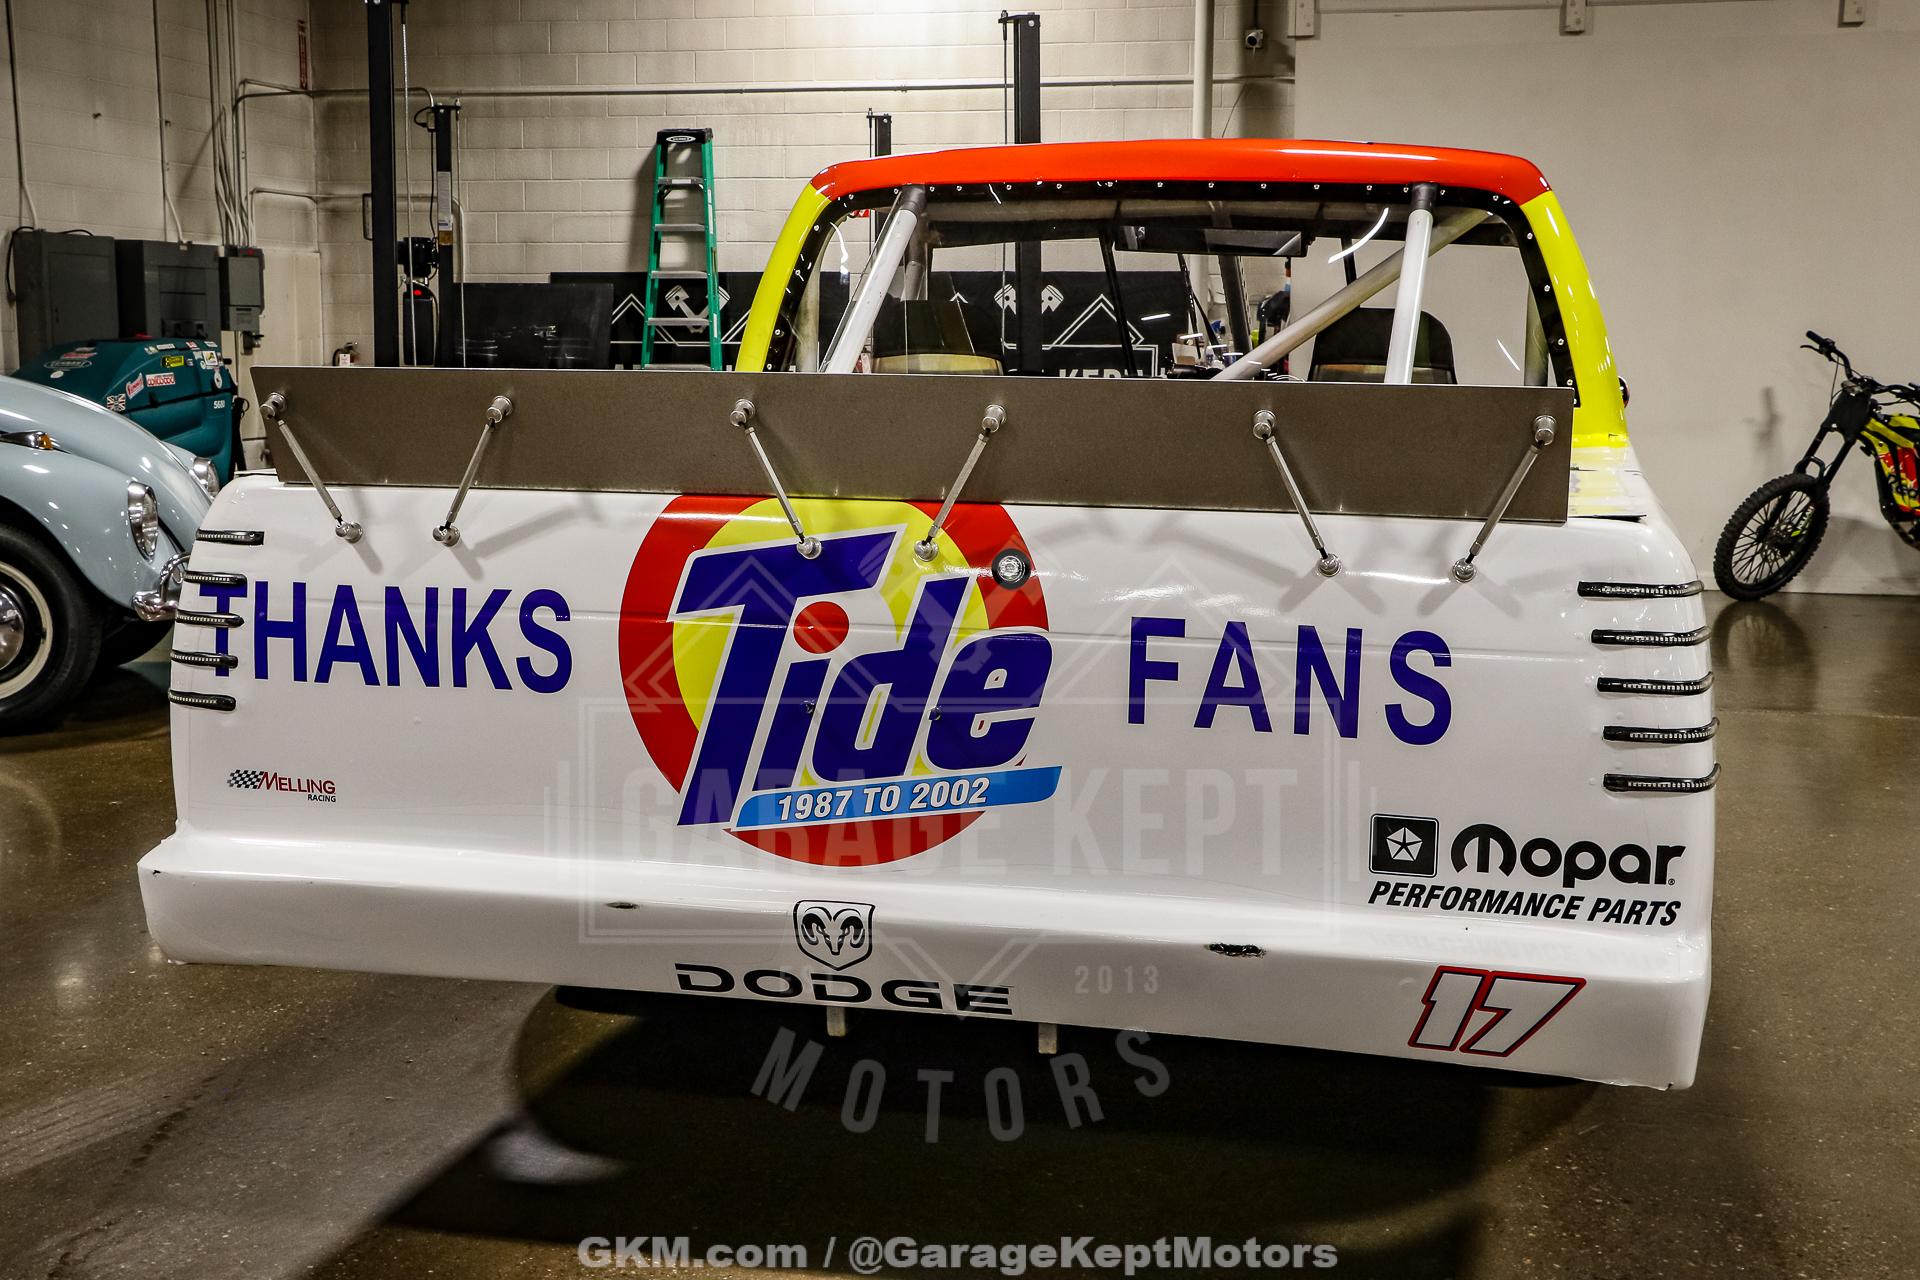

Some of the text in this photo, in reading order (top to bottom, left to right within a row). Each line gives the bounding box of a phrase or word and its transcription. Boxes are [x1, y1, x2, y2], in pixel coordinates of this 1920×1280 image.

[200, 579, 573, 694] THANKS
[667, 526, 1054, 830] Tide
[1127, 616, 1453, 746] FANS
[257, 771, 337, 794] MELLING
[307, 793, 337, 803] RACING
[778, 777, 990, 821] 1987 TO 2002
[1368, 881, 1682, 926] PERFORMANCE PARTS
[674, 963, 1015, 1015] DODGE
[1407, 965, 1587, 1057] 17
